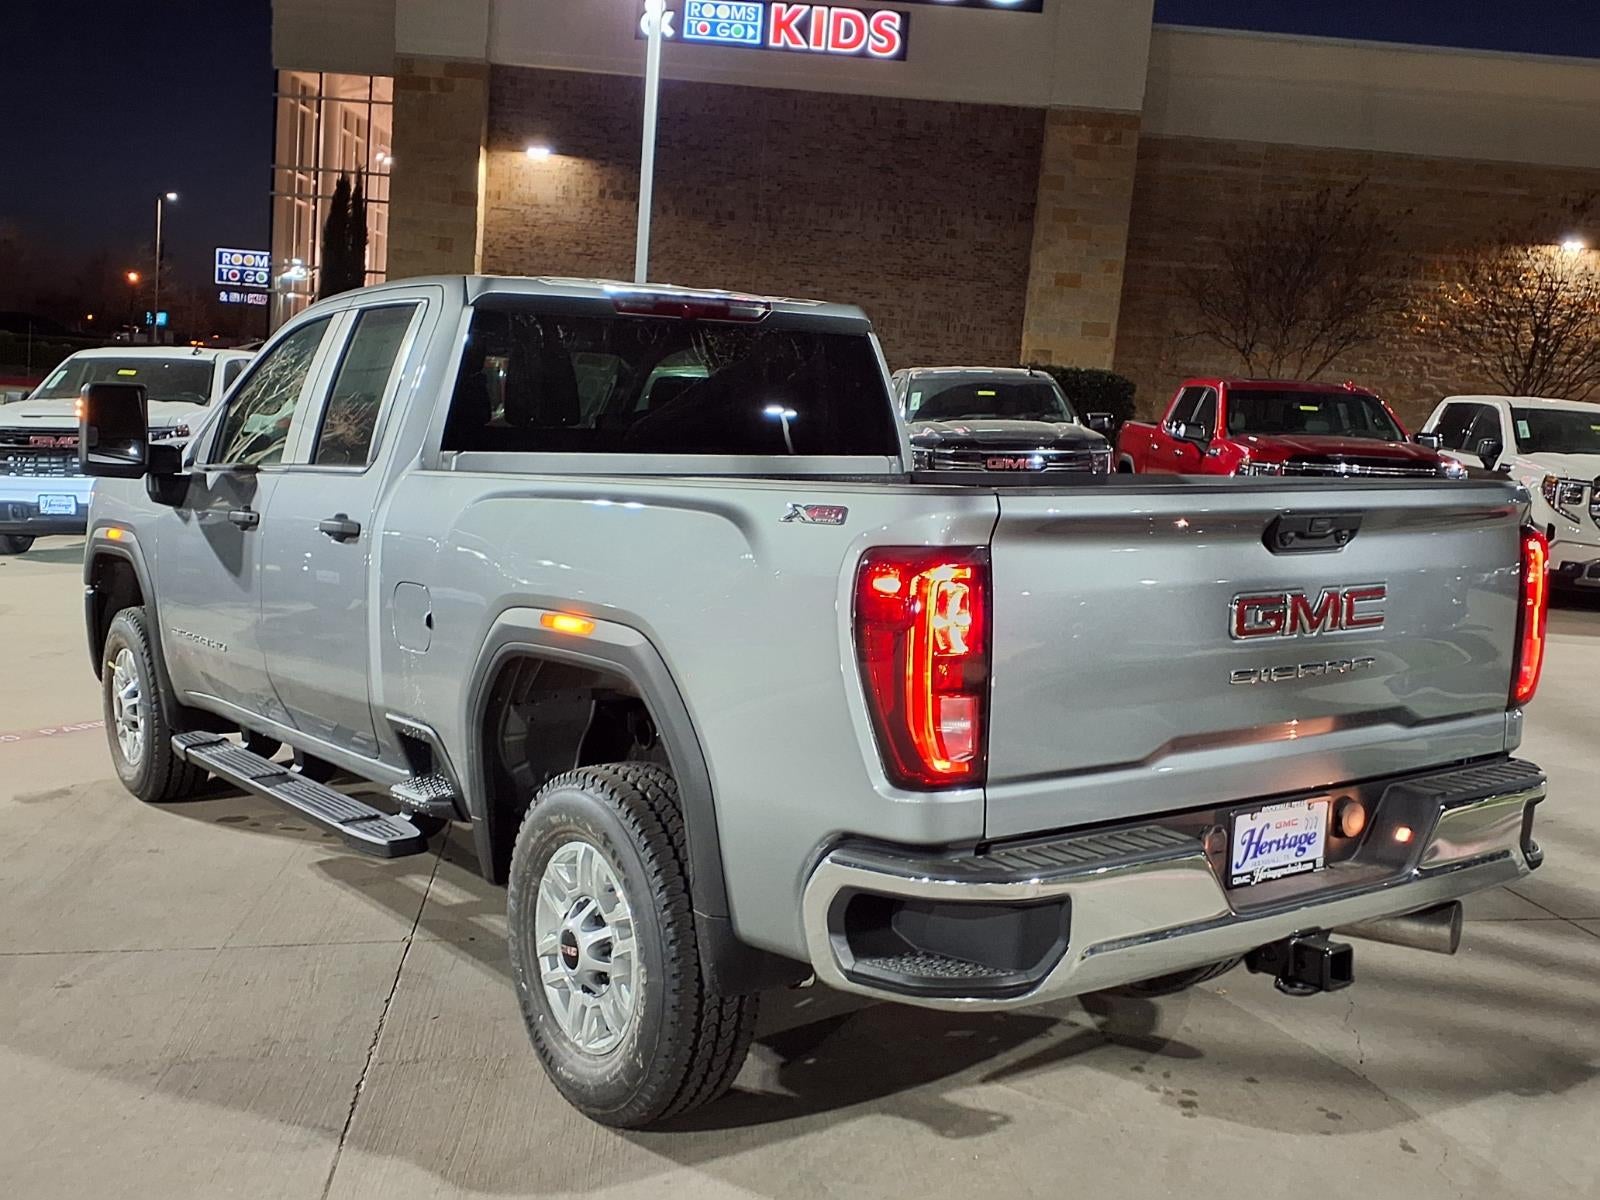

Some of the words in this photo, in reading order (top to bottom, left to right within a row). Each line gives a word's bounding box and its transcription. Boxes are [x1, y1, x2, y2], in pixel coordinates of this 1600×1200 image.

[690, 4, 756, 21] ROOMS
[689, 20, 709, 34] TO
[716, 25, 745, 39] GO
[769, 2, 903, 58] KIDS
[221, 268, 241, 282] TO
[243, 270, 268, 284] GO
[29, 435, 79, 448] GMC
[986, 458, 1042, 470] GMC
[1229, 583, 1388, 643] GMC
[1230, 656, 1376, 685] SIERRA
[1275, 818, 1299, 830] GMC
[1234, 822, 1317, 870] Heritage
